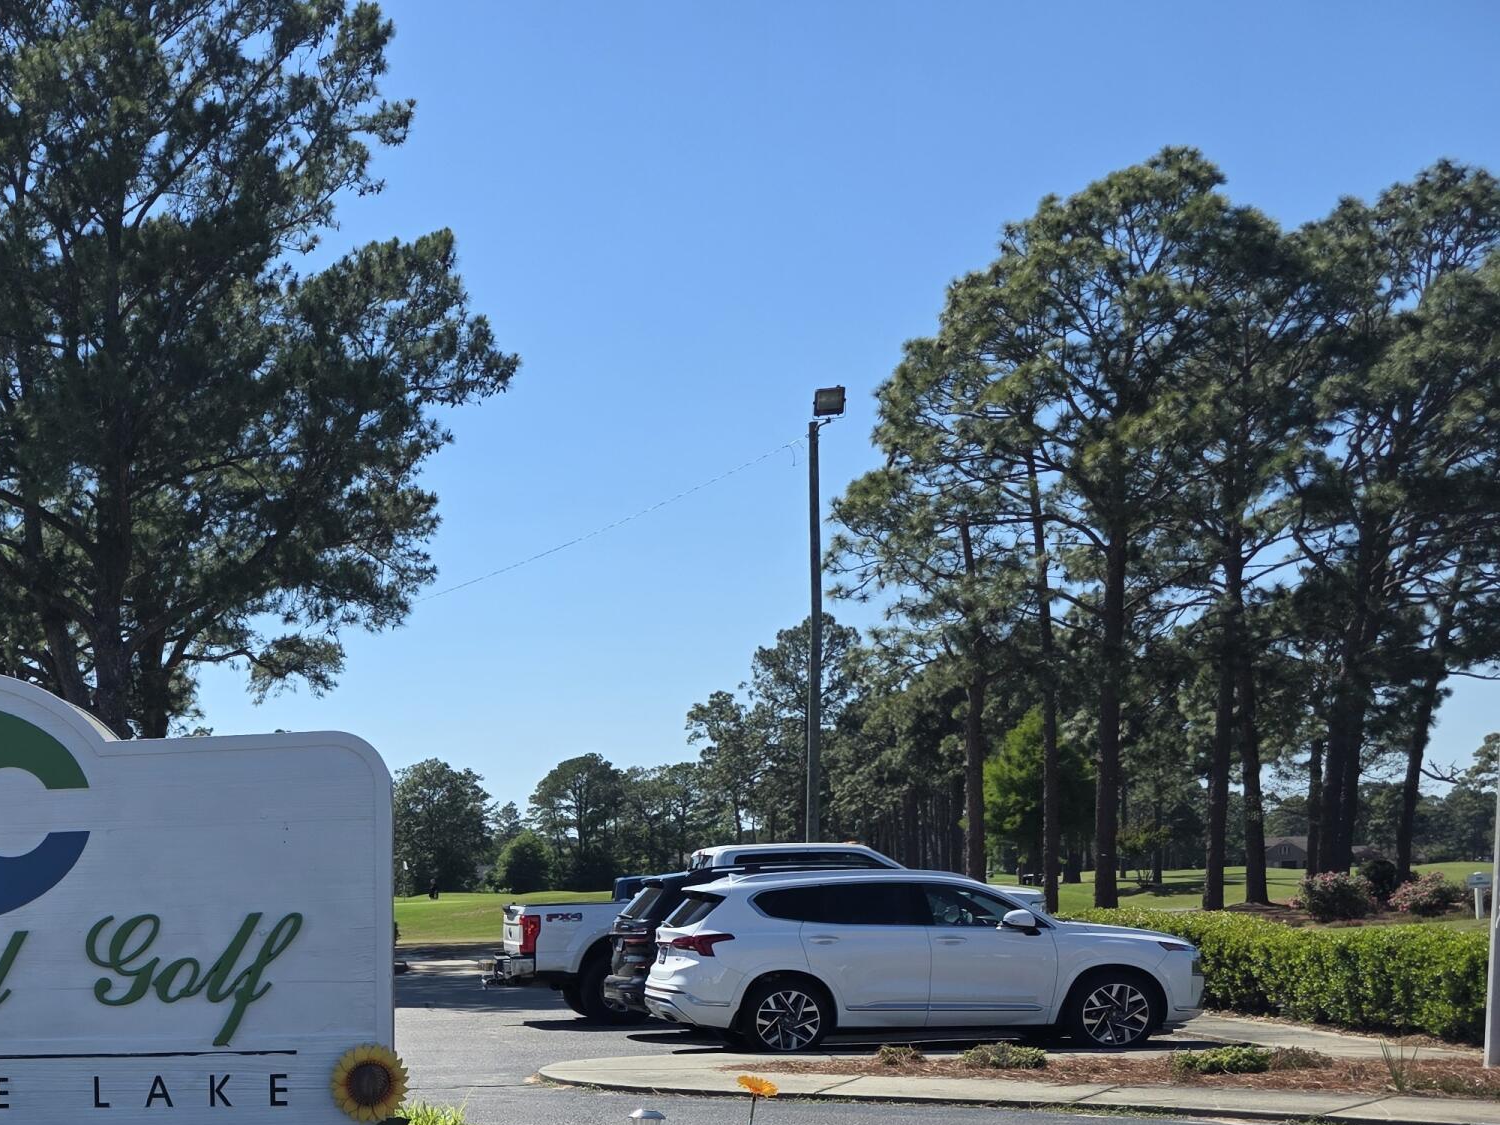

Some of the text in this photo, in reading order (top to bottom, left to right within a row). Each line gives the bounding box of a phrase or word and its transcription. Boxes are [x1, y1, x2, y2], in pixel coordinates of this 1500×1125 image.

[546, 912, 583, 922] FX4
[86, 912, 303, 1047] Golf
[93, 1073, 289, 1109] LAKE
